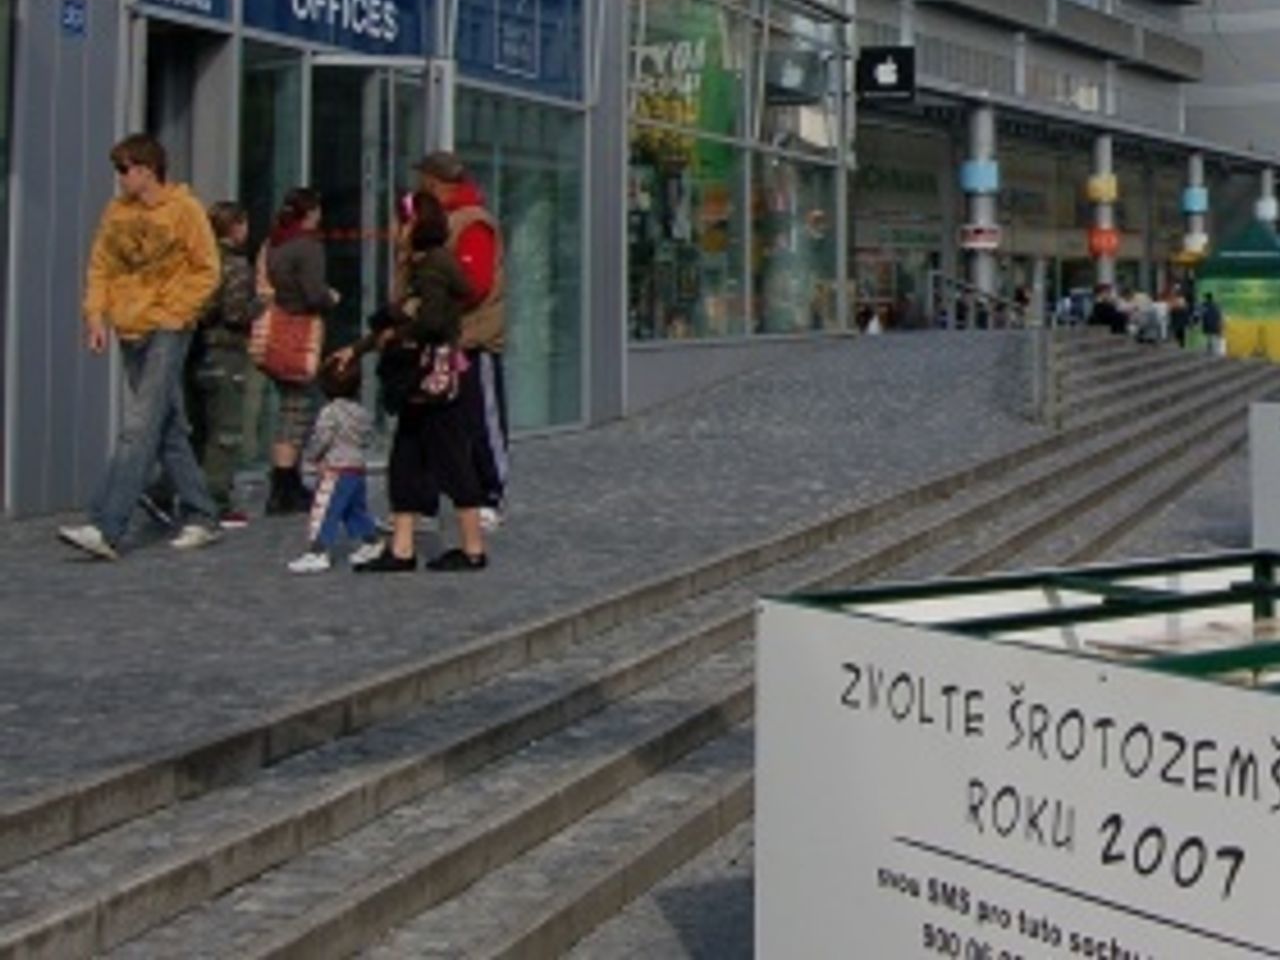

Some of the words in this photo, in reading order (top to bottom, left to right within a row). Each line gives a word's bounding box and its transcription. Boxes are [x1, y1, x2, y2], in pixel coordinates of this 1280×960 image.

[840, 662, 984, 737] ZVOLTE
[966, 777, 1075, 849] ROKU
[1099, 812, 1245, 900] 2007
[927, 877, 971, 915] SMS
[977, 899, 1011, 930] pro
[1017, 910, 1062, 947] tuto
